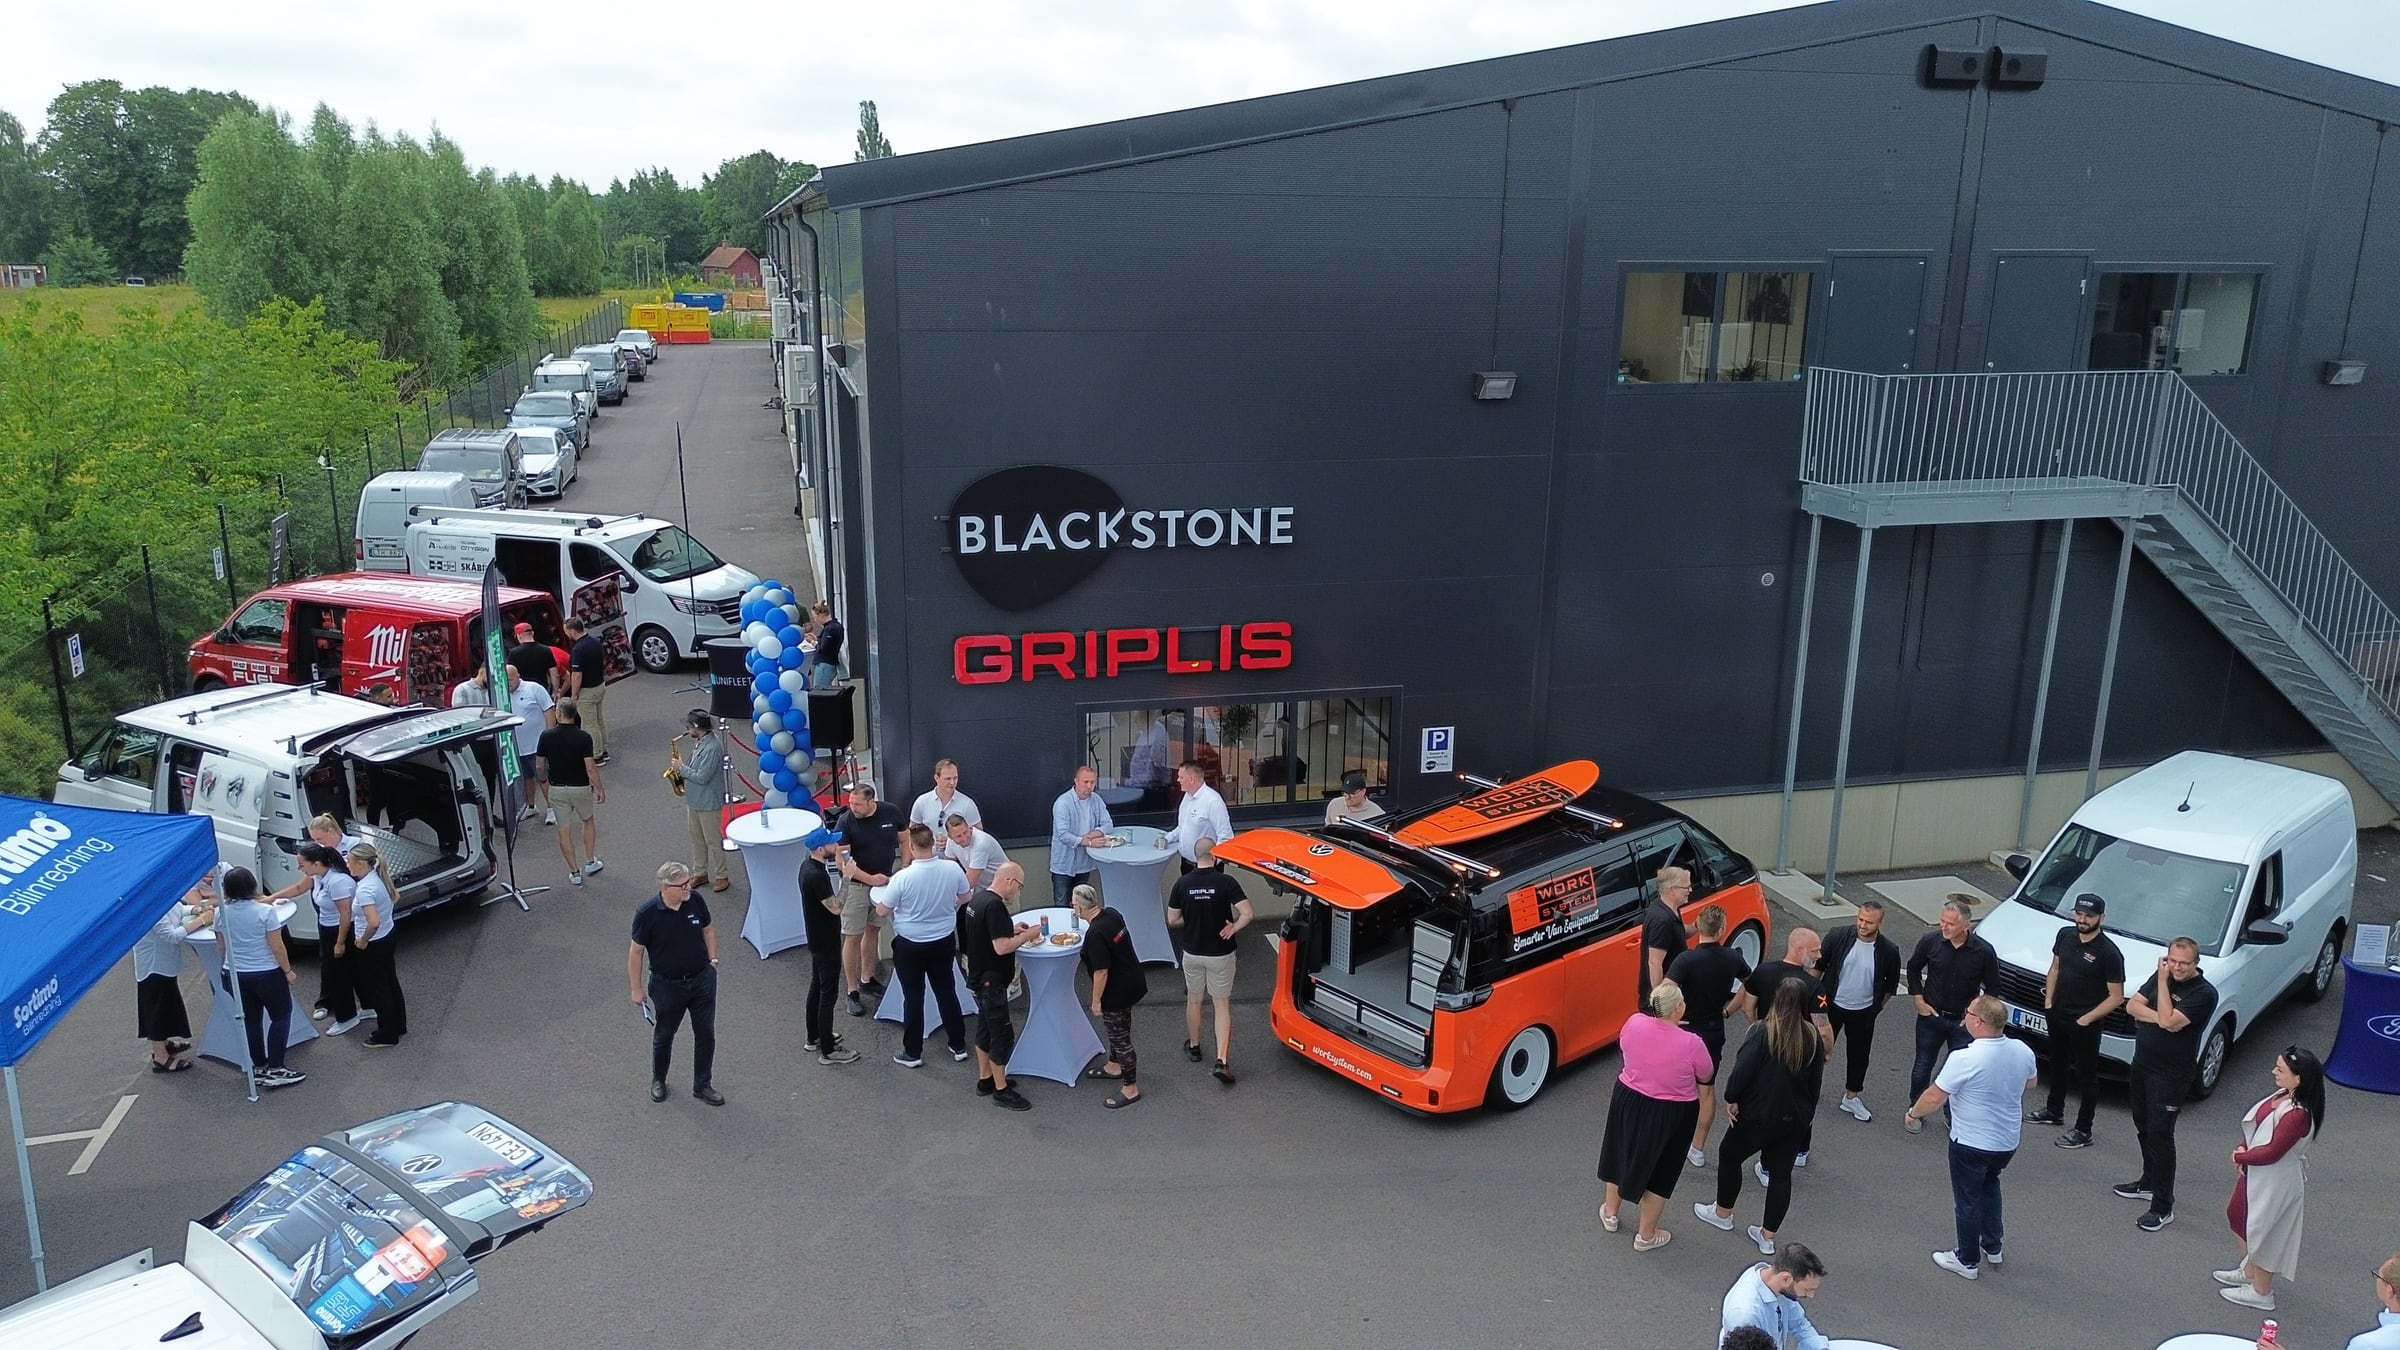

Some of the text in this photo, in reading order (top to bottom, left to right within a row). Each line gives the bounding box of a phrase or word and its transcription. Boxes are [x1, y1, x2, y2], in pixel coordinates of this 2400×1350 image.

[958, 506, 1294, 554] BLACKSTONE
[271, 526, 282, 589] IFLEET
[363, 623, 408, 669] Mil
[953, 621, 1292, 685] GRIPLIS
[716, 676, 752, 687] UNIFLEET
[1432, 731, 1446, 750] P
[0, 816, 72, 886] timo
[0, 837, 115, 916] Bilinredning
[1537, 874, 1590, 900] WORK
[1542, 894, 1592, 917] SYSTEM
[1513, 908, 1600, 952] Smarter Van Equipment
[14, 978, 58, 1029] Sortimo
[1313, 1045, 1373, 1081] worksystem.com
[472, 1126, 527, 1161] CEJ 49N
[315, 1306, 346, 1334] Sortimo
